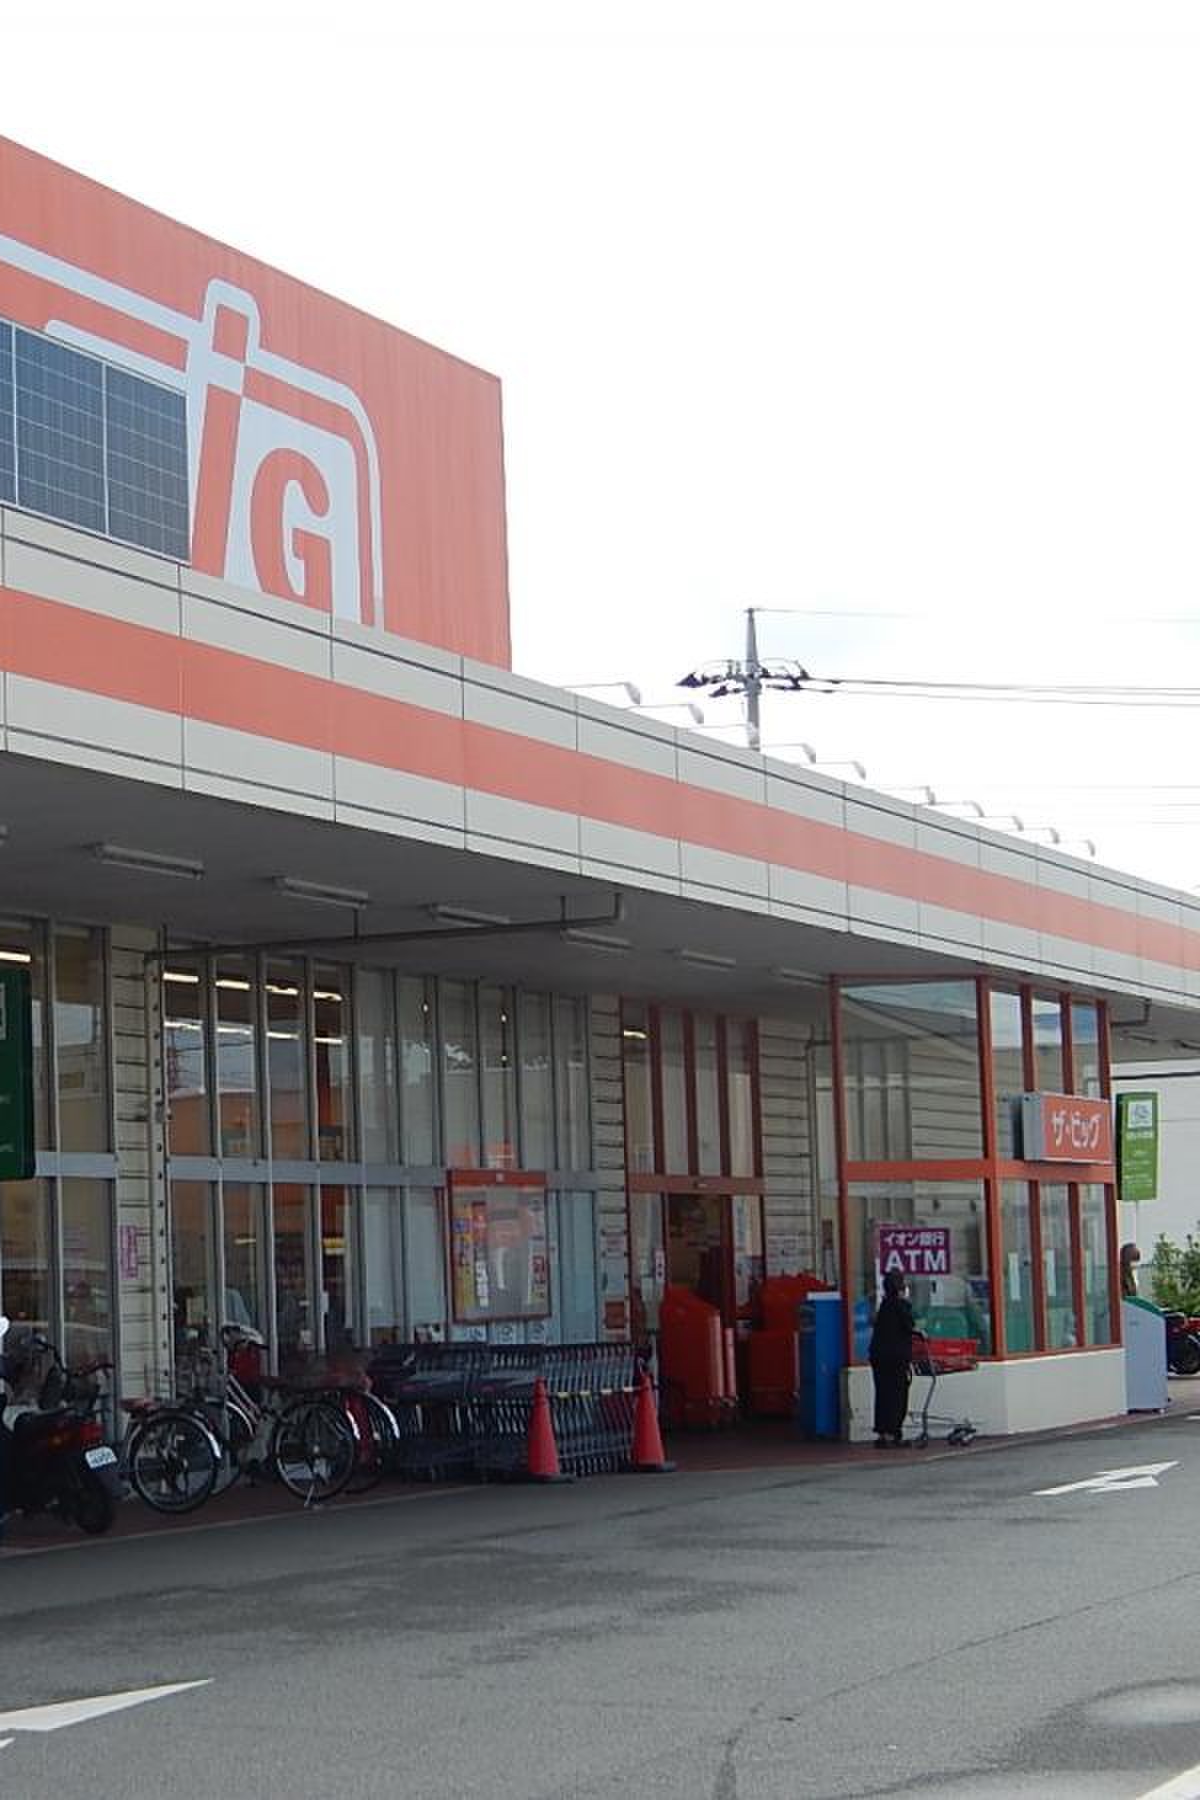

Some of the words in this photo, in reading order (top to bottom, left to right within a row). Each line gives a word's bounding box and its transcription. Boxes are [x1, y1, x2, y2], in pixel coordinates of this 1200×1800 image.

[883, 1231, 945, 1247] イオン銀行
[885, 1249, 946, 1273] ATM
